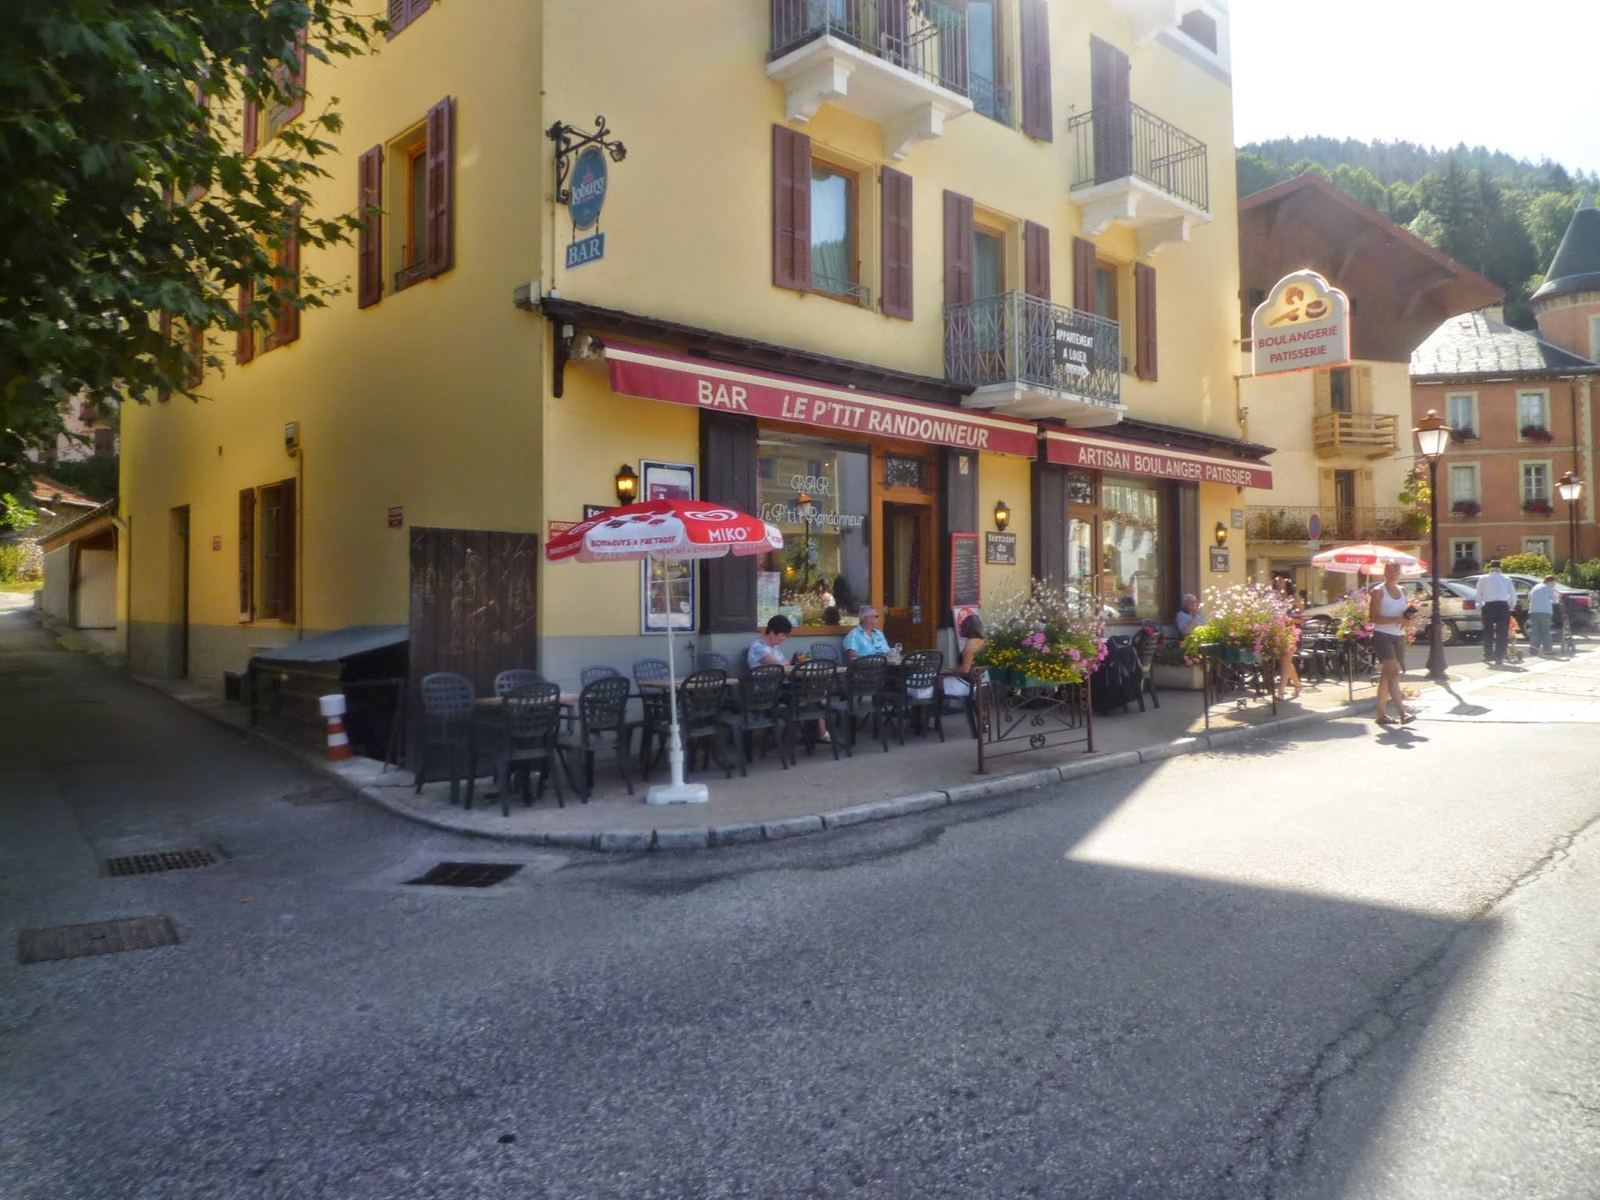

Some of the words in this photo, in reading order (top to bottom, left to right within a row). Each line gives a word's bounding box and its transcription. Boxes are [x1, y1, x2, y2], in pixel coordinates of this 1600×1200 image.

[568, 238, 602, 265] BAR
[1258, 325, 1339, 348] BOULANGERIE
[1269, 345, 1327, 363] PATISSERIE
[697, 379, 748, 411] BAR
[781, 395, 807, 419] LE
[811, 399, 865, 428] P'TIT
[868, 409, 989, 449] RANDONNEUR
[1078, 446, 1131, 470] ARTISAN
[1134, 455, 1202, 480] BOULANGER
[1205, 465, 1252, 486] PATISSIER
[791, 475, 833, 497] BAR
[806, 505, 865, 527] Randonneur
[707, 526, 748, 542] MIKO
